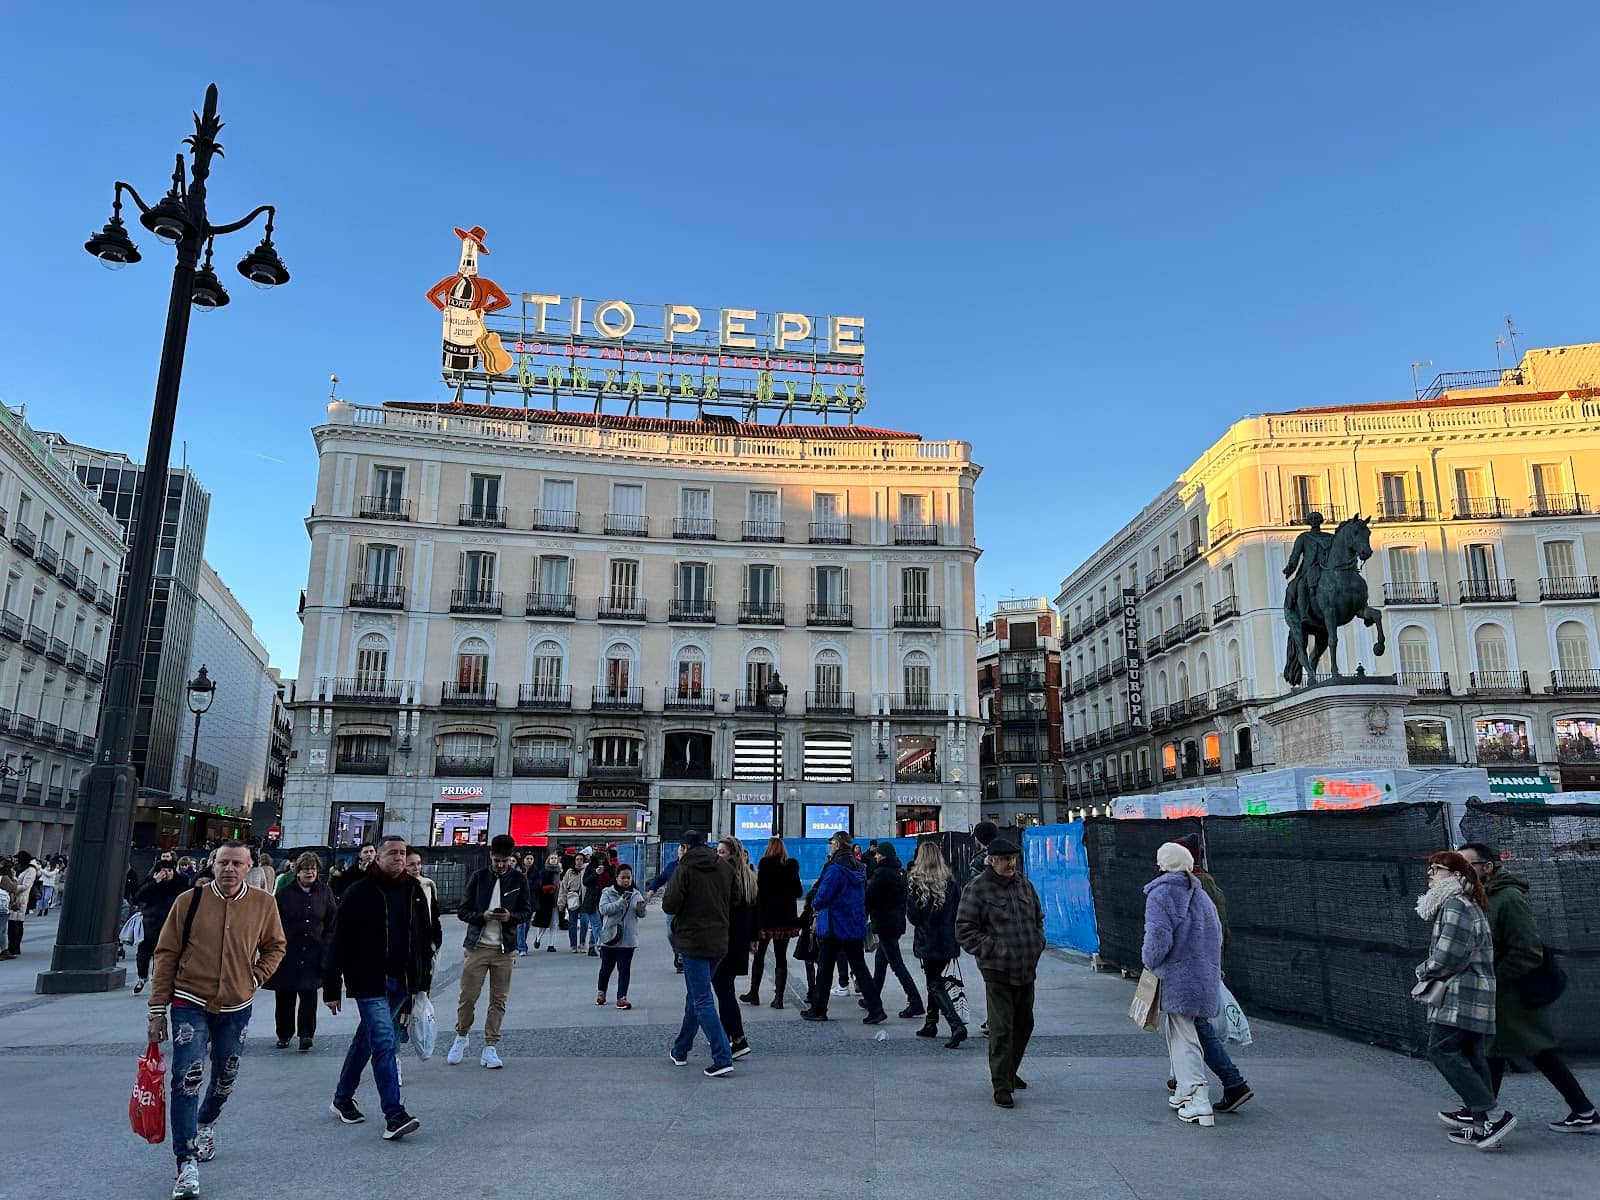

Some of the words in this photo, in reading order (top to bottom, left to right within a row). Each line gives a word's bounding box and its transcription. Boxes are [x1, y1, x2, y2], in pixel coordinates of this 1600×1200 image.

[522, 293, 635, 339] TIO
[664, 304, 866, 356] PEPE
[514, 340, 554, 355] SOL
[564, 343, 591, 357] DE
[600, 346, 711, 366] ANDALUCIA
[718, 355, 865, 376] EMBOTELLADO
[517, 354, 719, 400] GONZALEZ
[756, 371, 868, 409] BYASS
[1124, 595, 1138, 650] HOTEL
[1127, 658, 1143, 727] EUROPA
[441, 786, 483, 795] PRIMOR
[591, 788, 635, 798] PALAZZO
[580, 818, 622, 827] TABACOS
